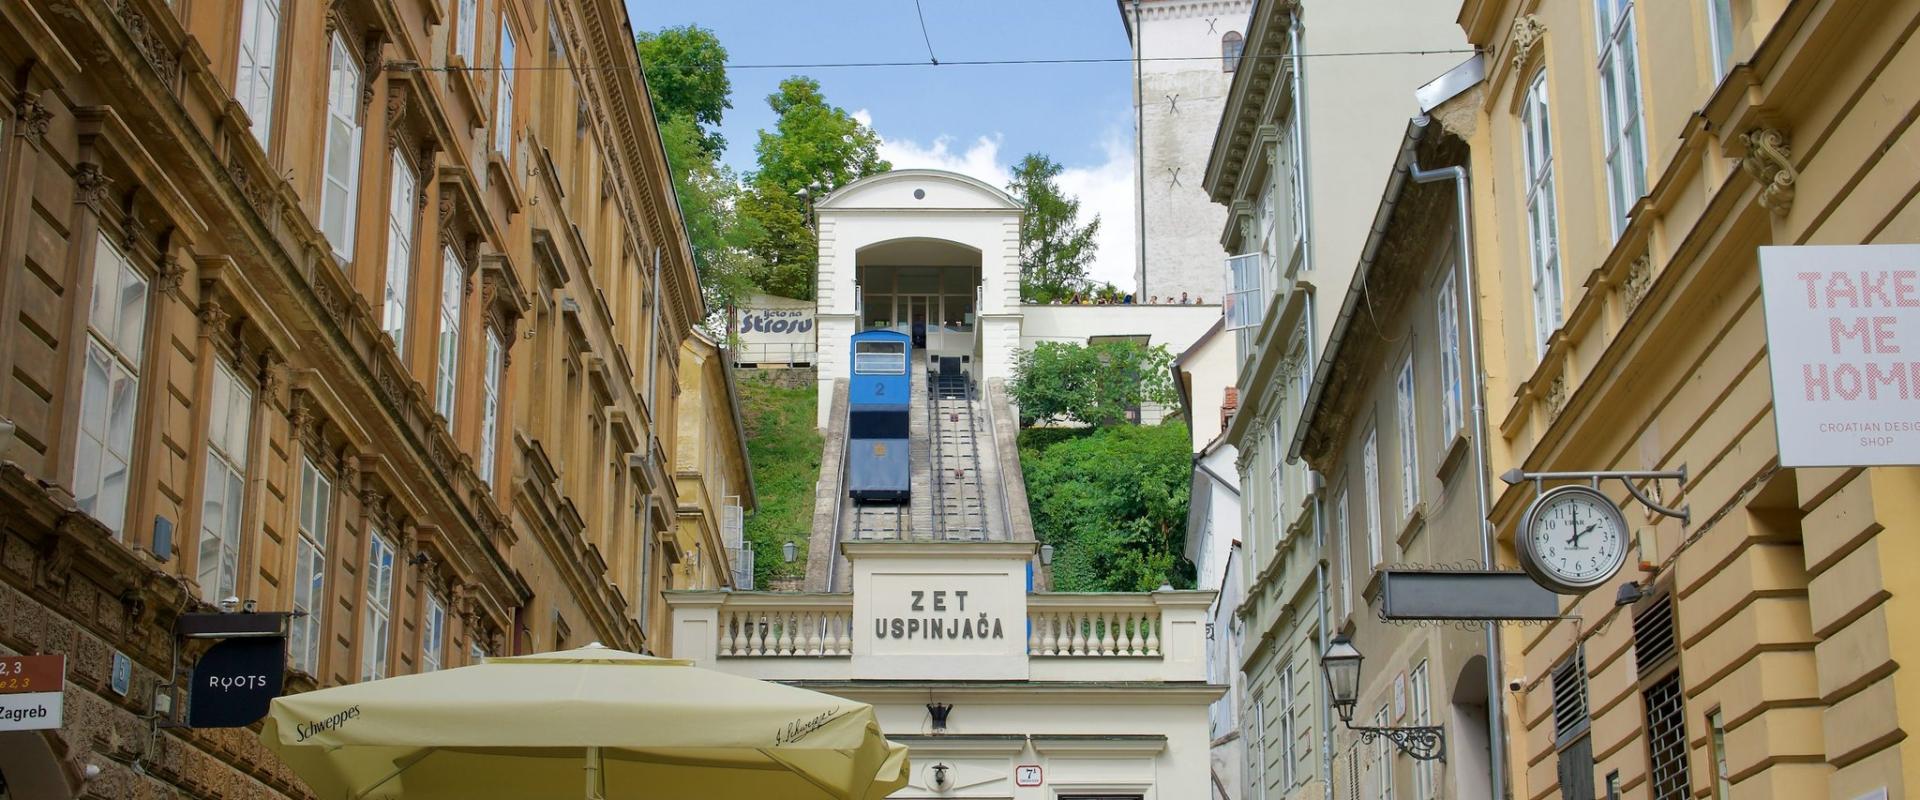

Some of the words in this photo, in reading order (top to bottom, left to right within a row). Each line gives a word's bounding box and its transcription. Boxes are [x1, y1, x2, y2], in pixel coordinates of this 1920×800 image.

[1797, 271, 1920, 309] TAKE
[741, 309, 813, 334] Štrosu
[1829, 317, 1901, 354] ME
[874, 382, 885, 396] 2
[1819, 422, 1881, 433] CROATIAN
[1860, 437, 1894, 447] SHOP
[1555, 508, 1564, 519] 11
[1544, 520, 1556, 530] 10
[1597, 518, 1603, 529] 2
[1543, 533, 1549, 544] 9
[1603, 531, 1608, 542] 3
[1549, 546, 1555, 557] 8
[1599, 546, 1605, 556] 4
[1561, 558, 1567, 568] 7
[1575, 561, 1581, 571] 6
[1591, 557, 1597, 567] 5
[911, 591, 968, 611] ZET
[875, 612, 1004, 639] USPINJAČA
[14, 661, 22, 674] 3
[22, 677, 30, 688] 3
[297, 705, 360, 742] Schweppes
